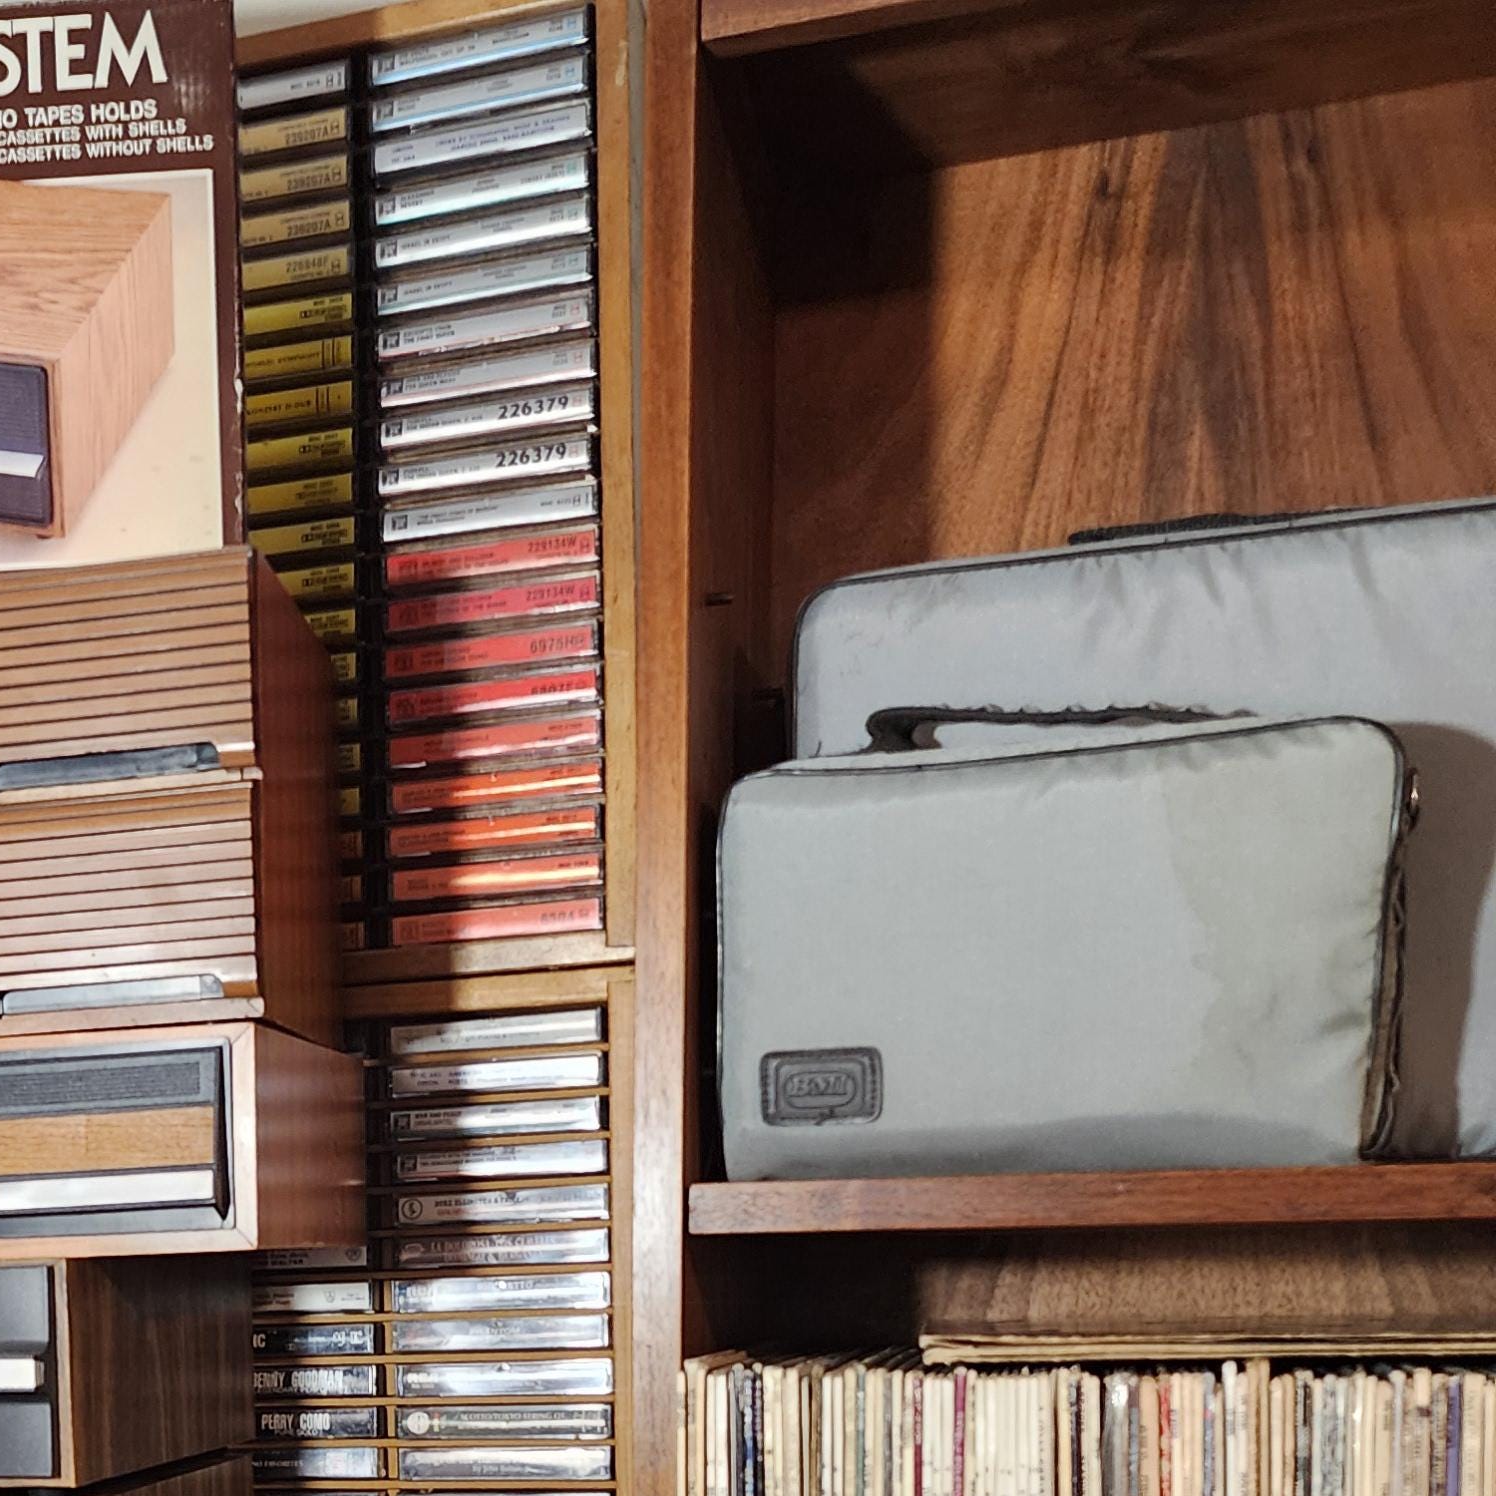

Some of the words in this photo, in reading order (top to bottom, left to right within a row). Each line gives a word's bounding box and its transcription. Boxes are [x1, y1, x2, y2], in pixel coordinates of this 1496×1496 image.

[24, 105, 84, 127] TAPES
[91, 99, 157, 123] HOLDS
[85, 123, 122, 141] WITH
[128, 118, 186, 136] SHELLS
[87, 140, 152, 158] WITHOUT
[156, 135, 213, 154] SHELLS
[498, 395, 568, 419] 226379
[496, 443, 566, 467] 226379
[291, 1369, 344, 1391] GOODMAN
[261, 1414, 294, 1431] PERRY
[299, 1413, 330, 1431] COMO
